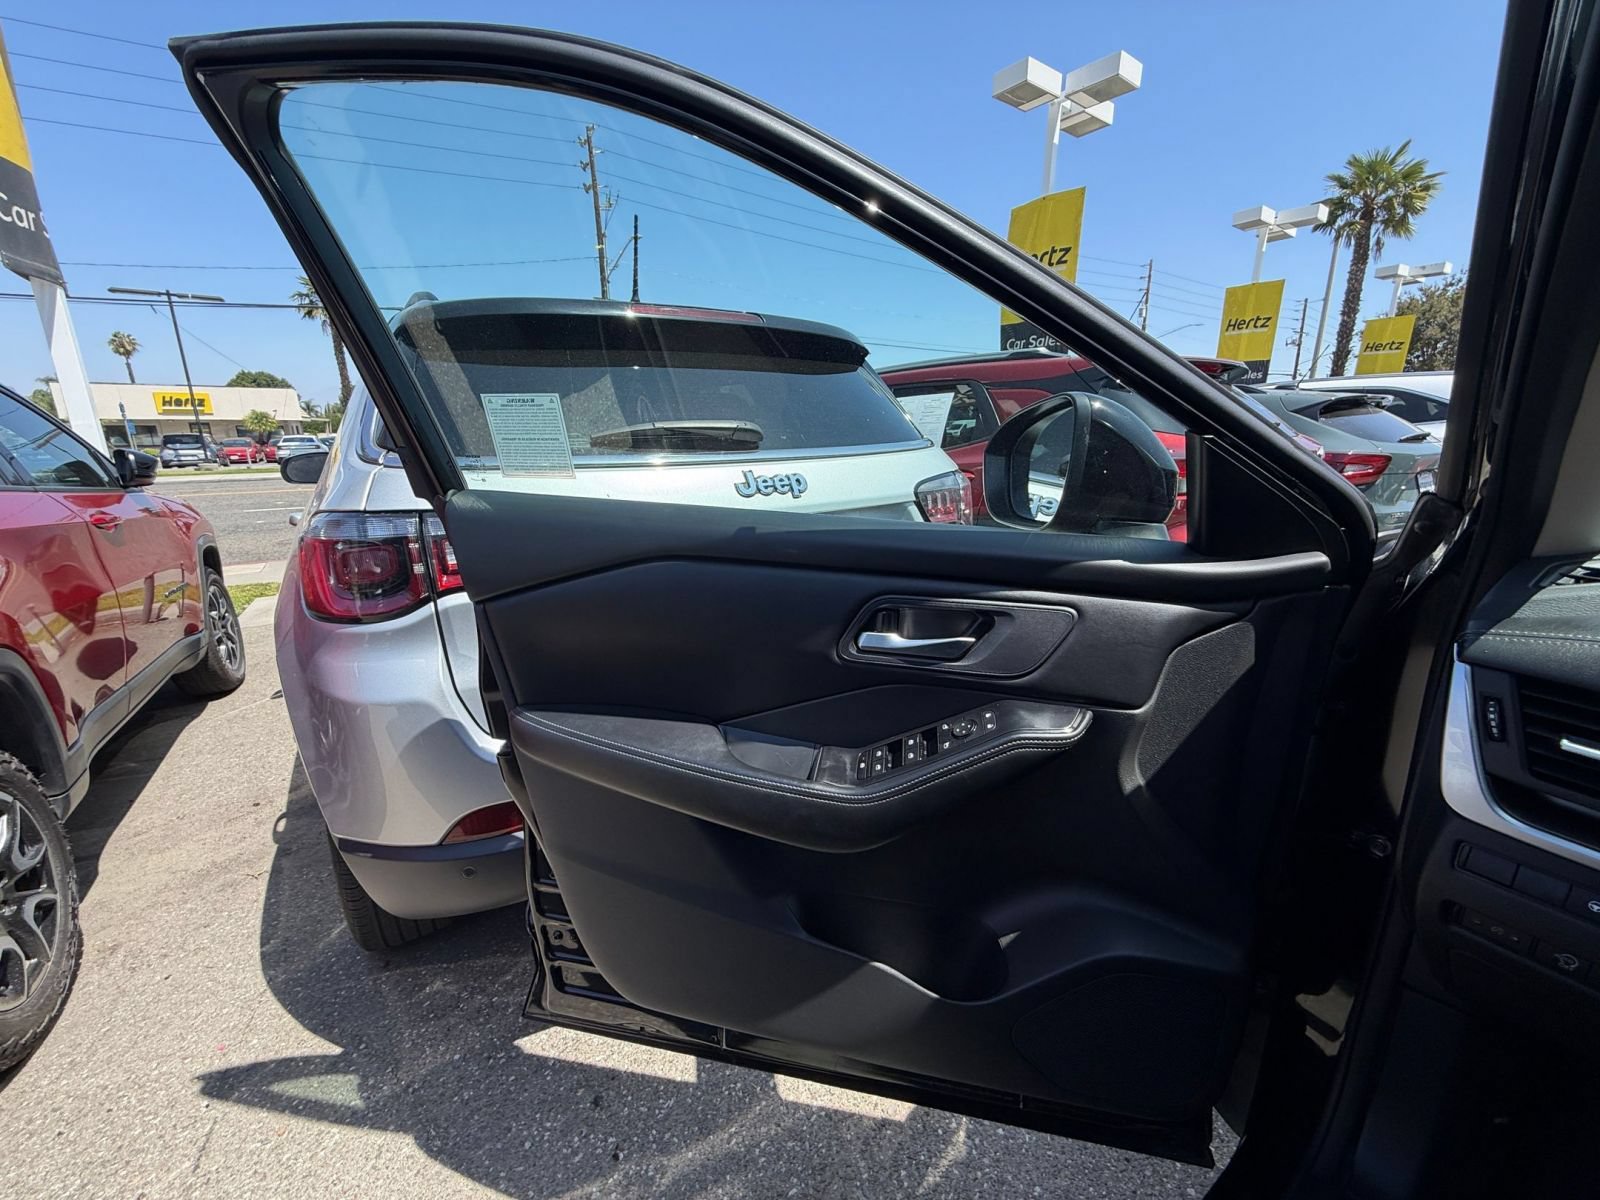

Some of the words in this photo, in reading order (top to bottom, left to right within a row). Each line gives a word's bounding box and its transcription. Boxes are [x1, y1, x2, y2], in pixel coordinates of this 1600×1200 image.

[1031, 246, 1072, 267] rtz
[1225, 315, 1272, 332] Hertz
[1006, 338, 1026, 351] Car
[1364, 340, 1405, 352] Hertz
[1241, 370, 1263, 379] les
[734, 465, 808, 498] Jeep
